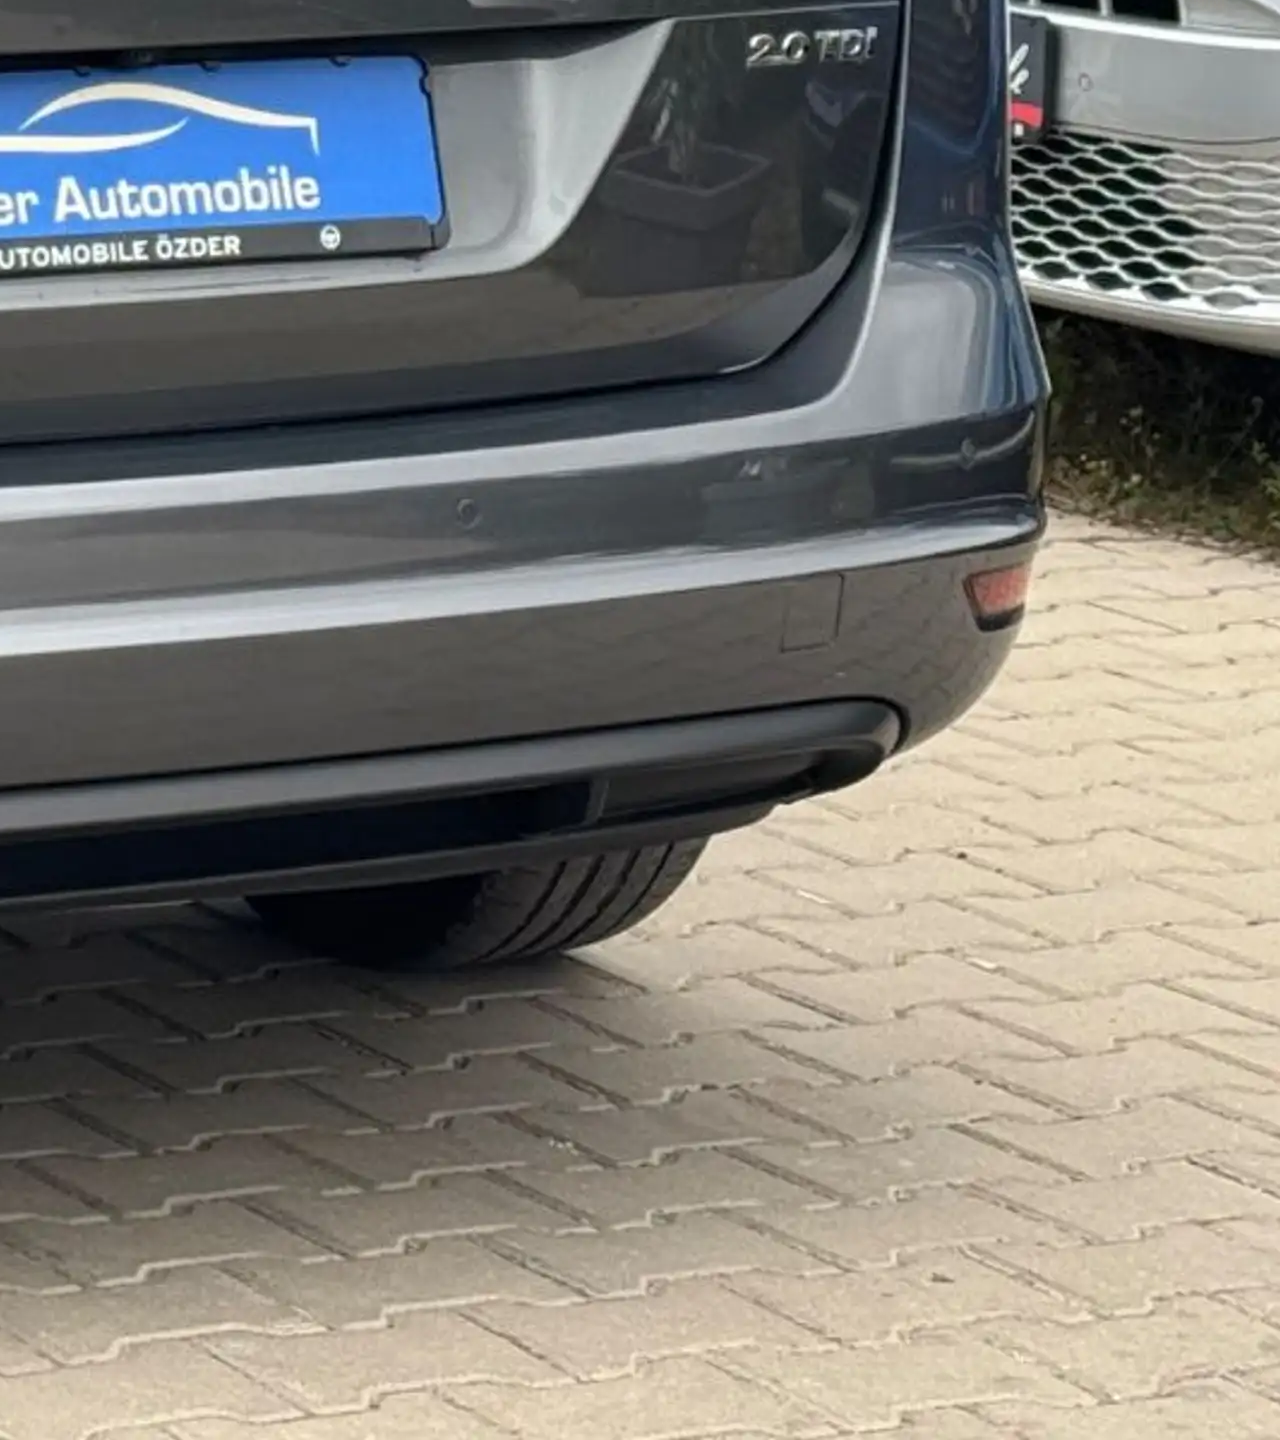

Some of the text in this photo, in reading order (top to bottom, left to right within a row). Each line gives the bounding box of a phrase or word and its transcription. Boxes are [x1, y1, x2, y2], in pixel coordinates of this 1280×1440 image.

[813, 26, 878, 63] TDI
[54, 165, 321, 223] Automobile
[155, 233, 241, 260] ÖZDER
